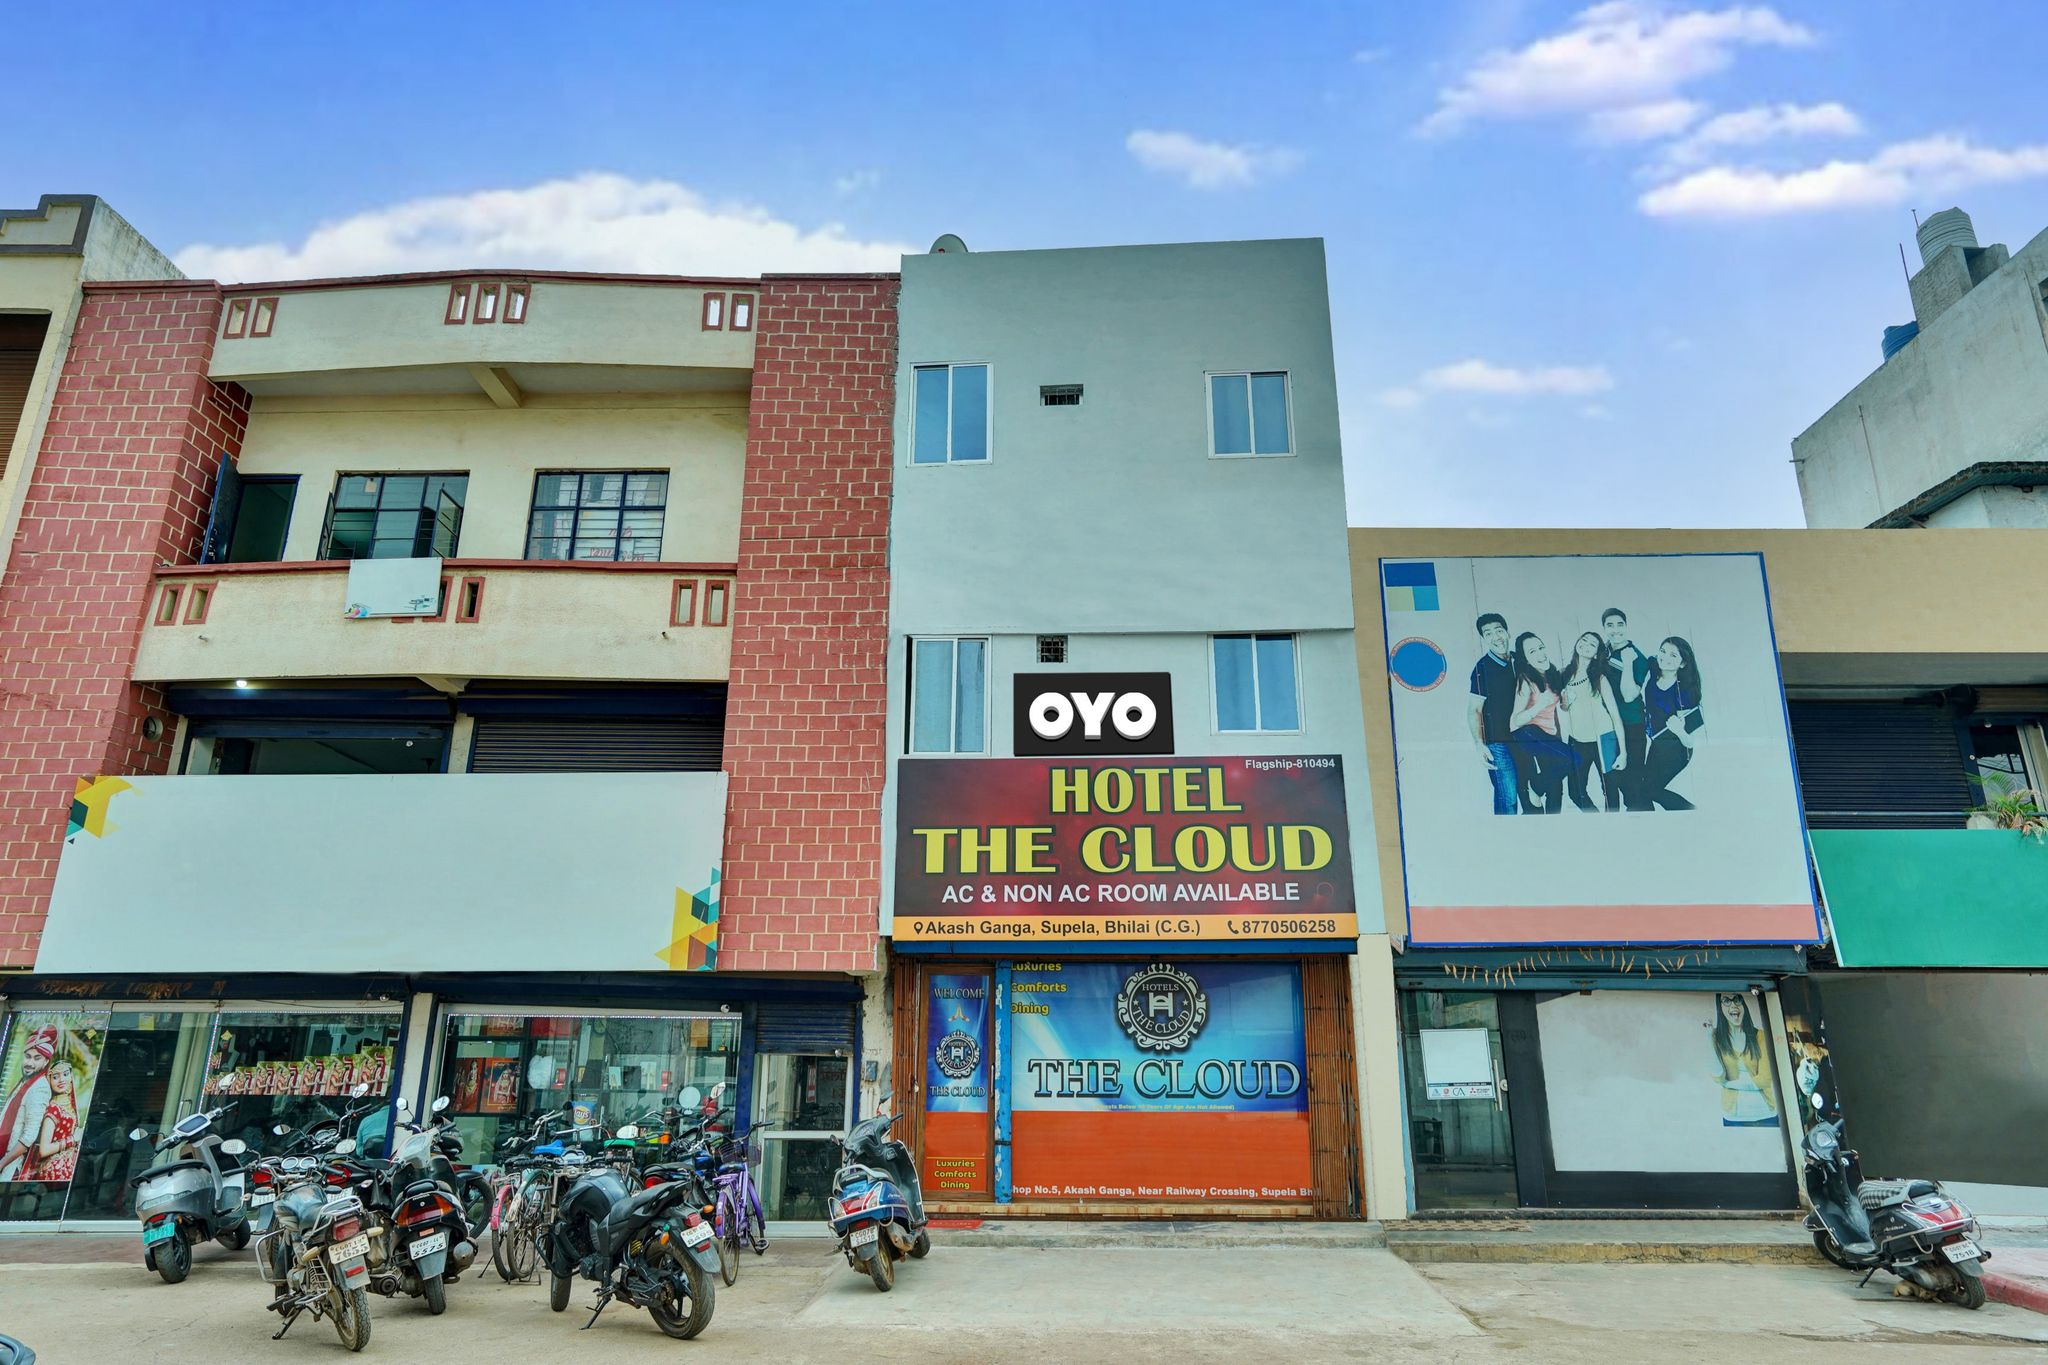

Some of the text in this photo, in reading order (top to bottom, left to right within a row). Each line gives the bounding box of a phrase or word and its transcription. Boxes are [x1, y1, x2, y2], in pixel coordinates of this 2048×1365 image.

[1029, 692, 1157, 740] OYO
[1245, 759, 1336, 771] Flagship-810494
[1051, 767, 1243, 813] HOTEL
[912, 825, 1333, 873] THE CLOUD
[941, 882, 1300, 903] AC & NON AC ROOM AVAILABLE
[925, 919, 1336, 936] Akash Ganga, Supela, Bhilai (C.G.) 8770506258
[1011, 961, 1062, 972] Luxuries
[934, 987, 986, 1000] WELCOME
[1011, 982, 1068, 993] Comforts
[1142, 983, 1180, 992] HOTELS
[1133, 1006, 1191, 1034] THE CLOUD
[1028, 1058, 1302, 1099] THE CLOUD
[930, 1086, 986, 1098] THE CLOUD
[936, 1159, 976, 1167] Luxuries
[934, 1170, 977, 1178] Comforts
[940, 1180, 970, 1190] Dining
[1011, 1184, 1032, 1195] hop
[1034, 1185, 1061, 1195] No.5,
[1064, 1185, 1096, 1195] Akash
[1099, 1186, 1135, 1197] Ganga,
[1138, 1187, 1163, 1195] Near
[1166, 1187, 1207, 1198] Railway
[1210, 1187, 1258, 1198] Crossing,
[1261, 1187, 1297, 1197] Supela
